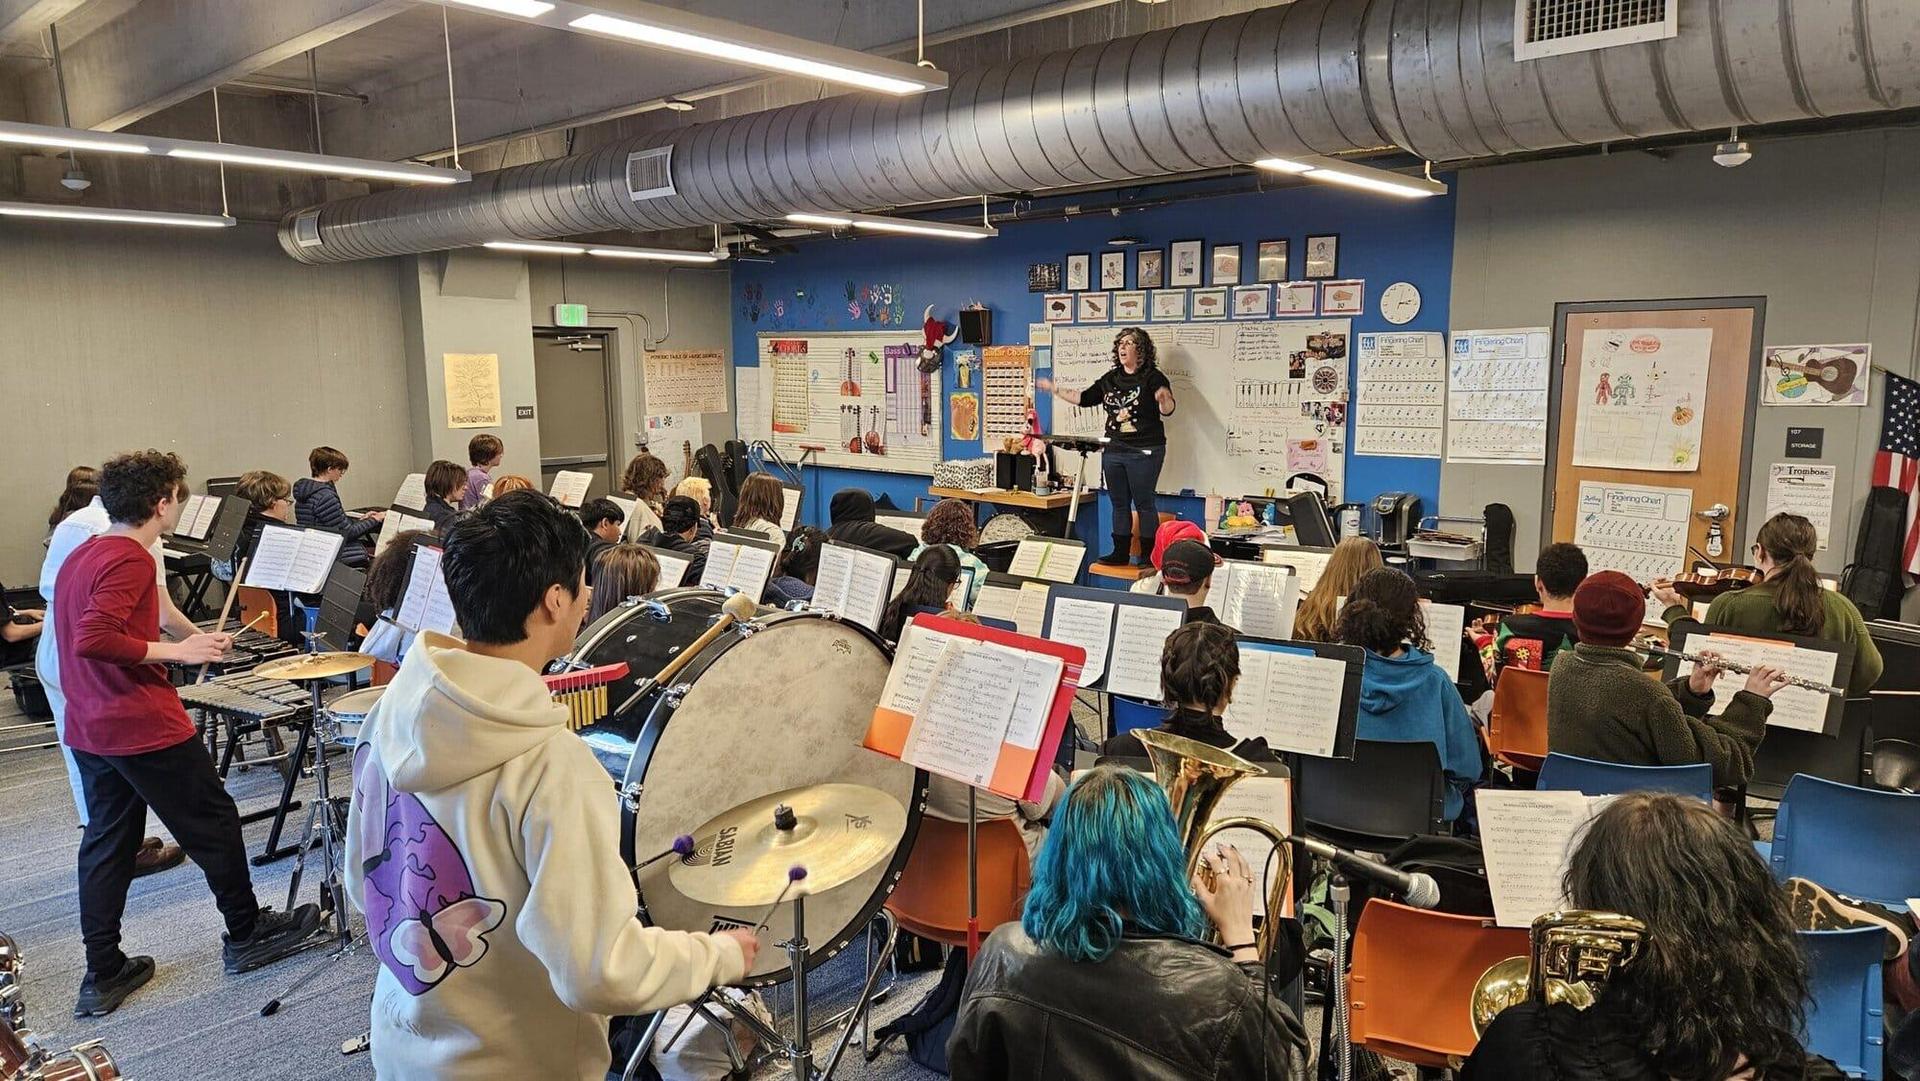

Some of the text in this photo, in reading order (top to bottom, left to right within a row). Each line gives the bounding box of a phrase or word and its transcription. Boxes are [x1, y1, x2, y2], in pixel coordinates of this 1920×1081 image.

[1381, 337, 1407, 345] Fingering
[1475, 337, 1504, 345] Fingering
[518, 409, 532, 417] EXIT
[1787, 466, 1830, 476] Trombone
[1607, 493, 1640, 505] Fingering
[1641, 495, 1662, 505] Chart
[712, 826, 738, 867] SABIAN
